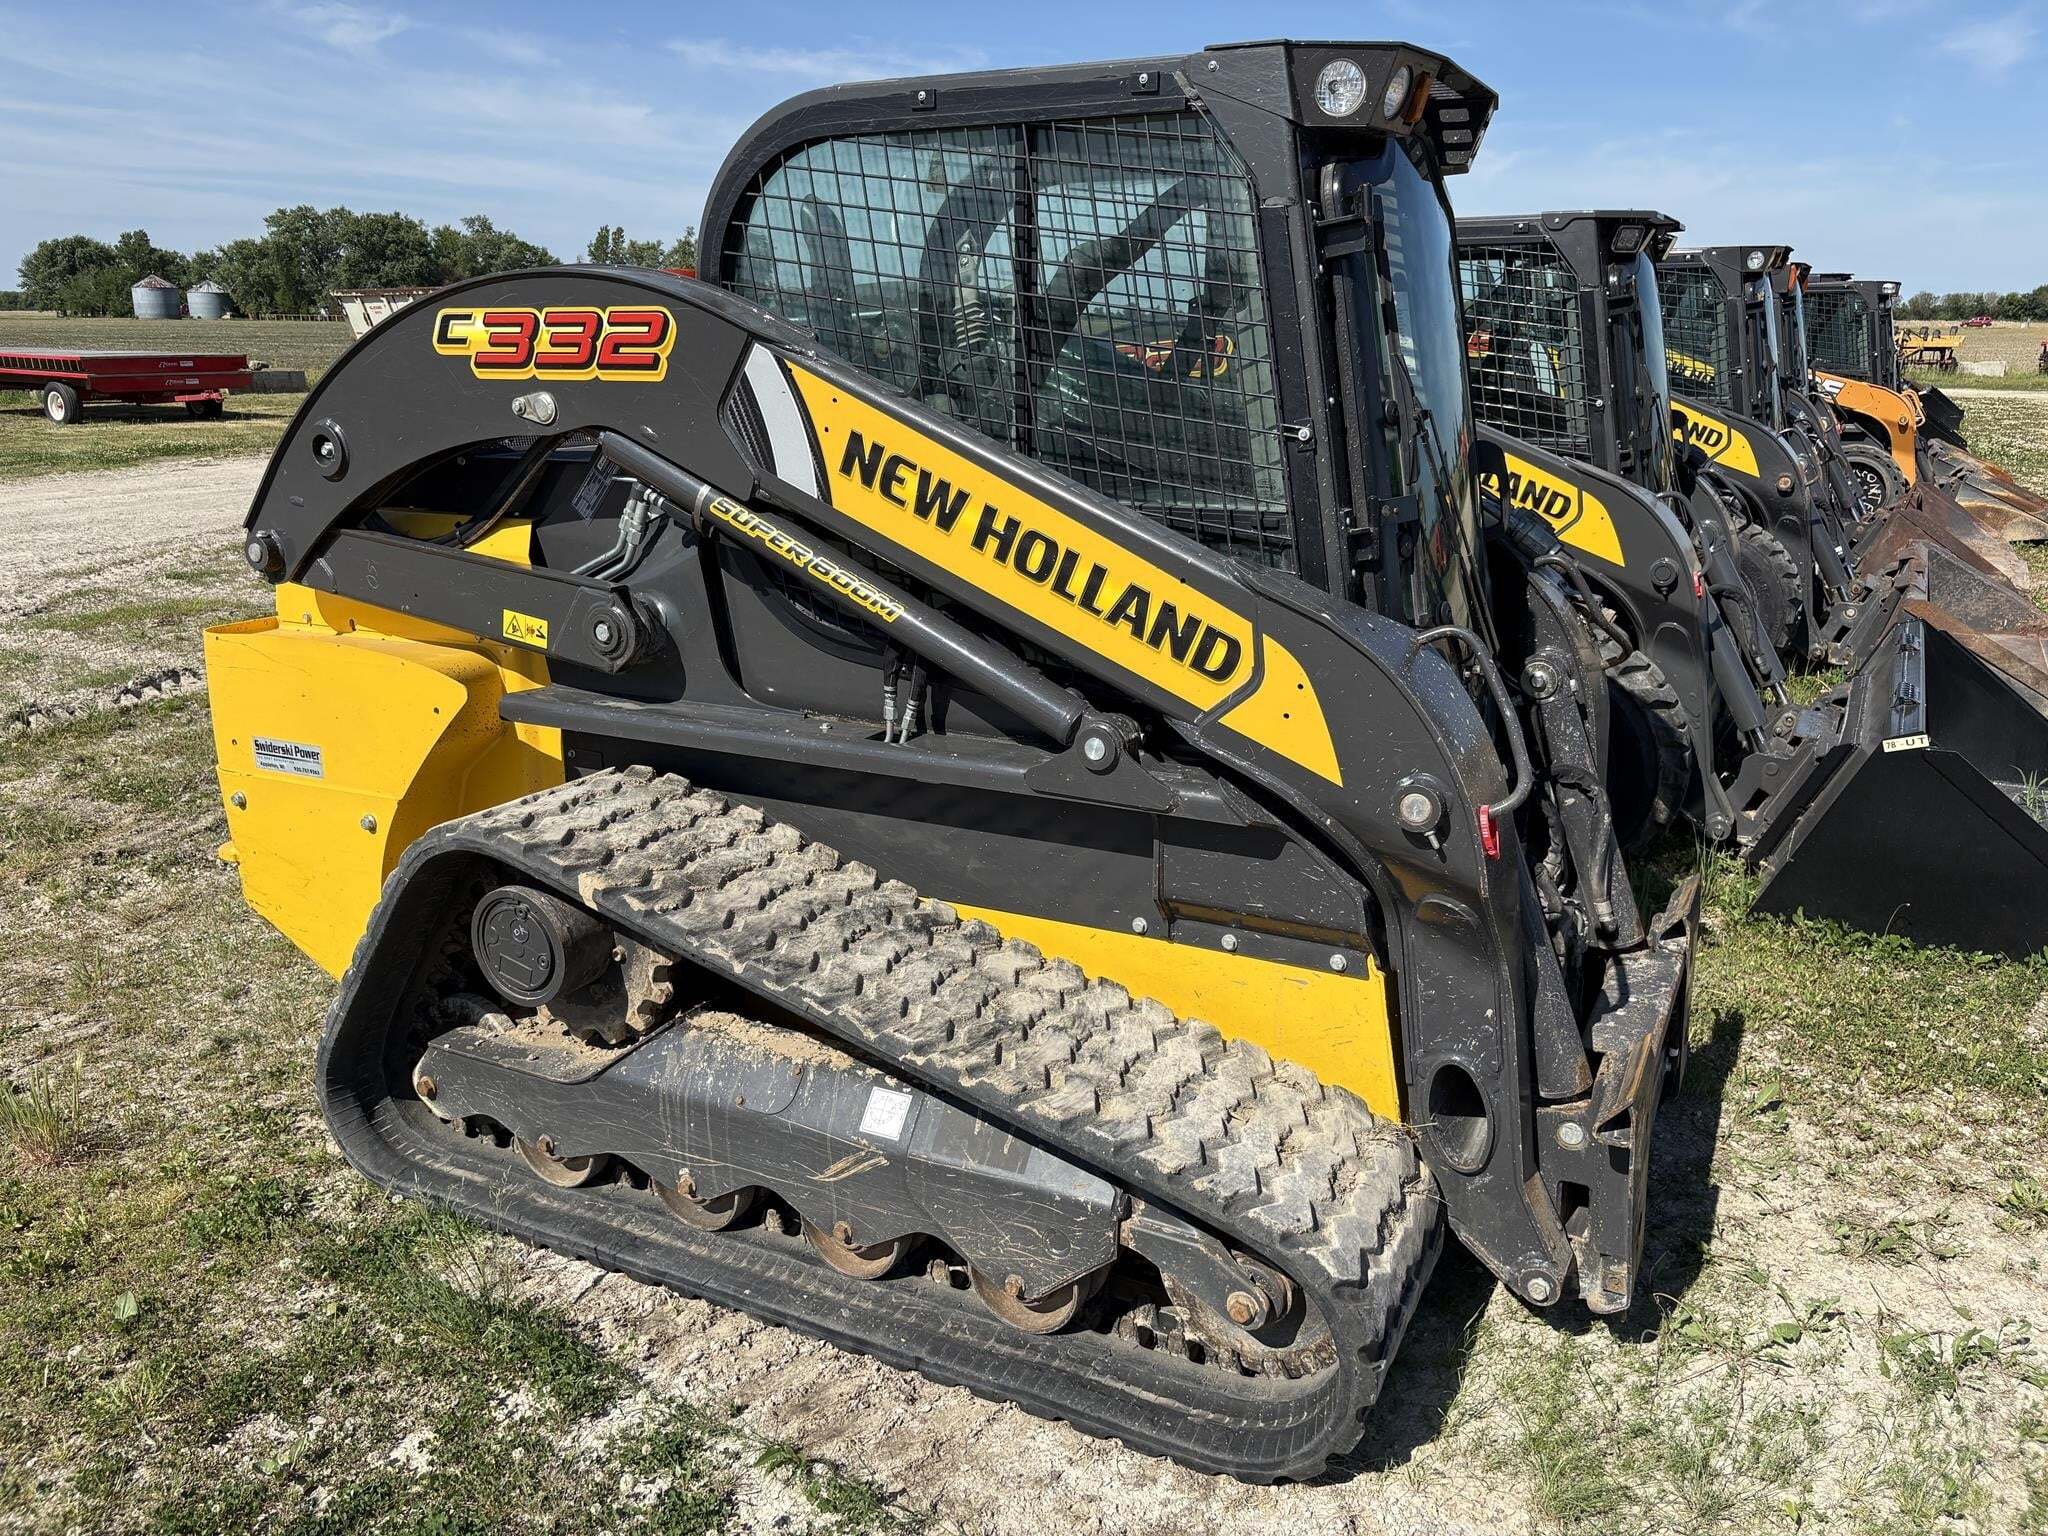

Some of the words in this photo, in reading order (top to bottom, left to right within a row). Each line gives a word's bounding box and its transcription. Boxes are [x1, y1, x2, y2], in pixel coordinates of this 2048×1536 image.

[434, 308, 675, 380] C332
[710, 497, 814, 568] SUPER
[808, 556, 905, 623] BOOM
[839, 429, 971, 535] NEW
[970, 502, 1243, 684] HOLLAND
[254, 739, 294, 757] Swiderski
[294, 745, 321, 761] Power
